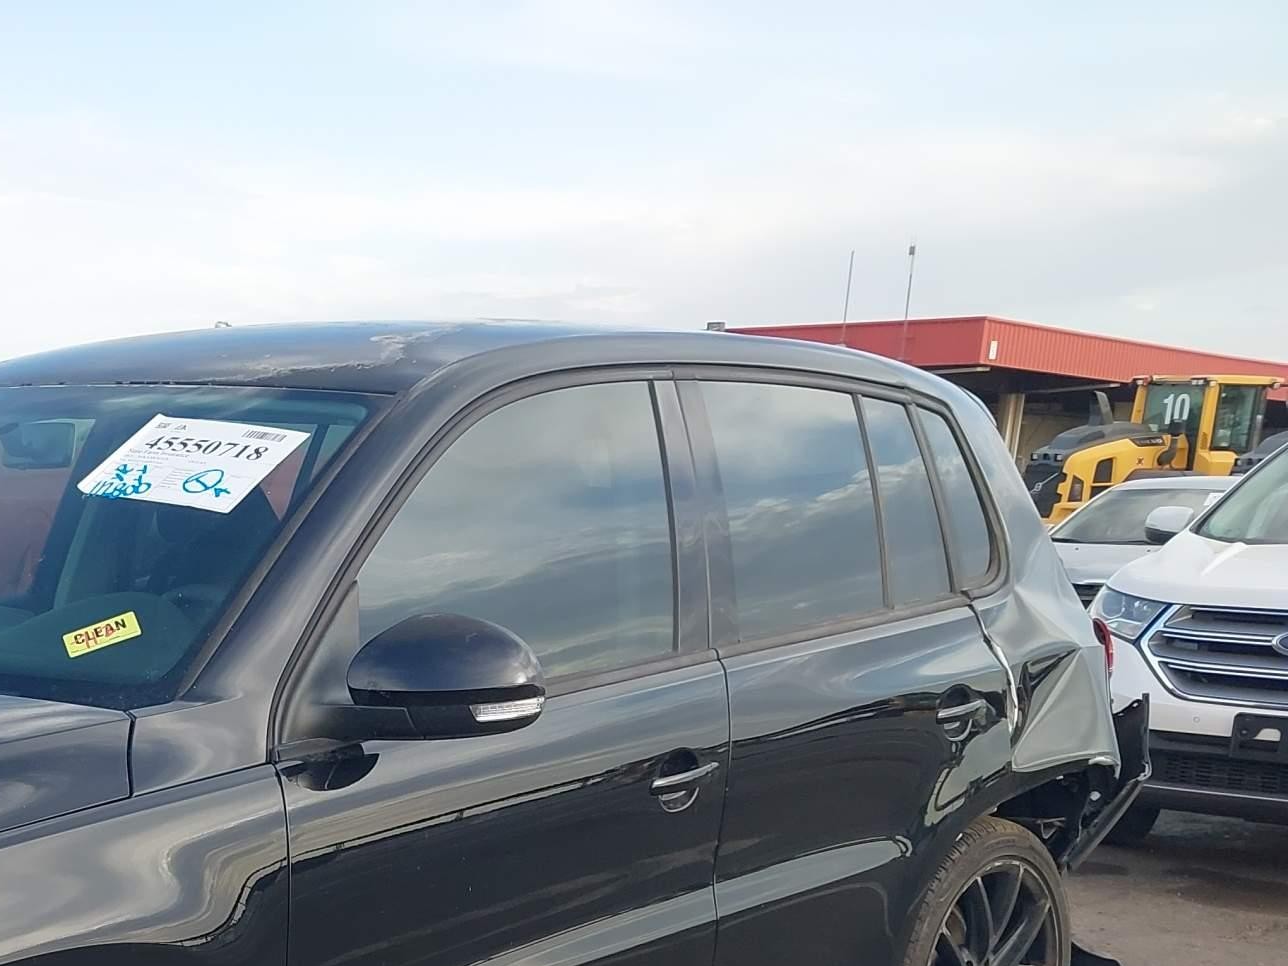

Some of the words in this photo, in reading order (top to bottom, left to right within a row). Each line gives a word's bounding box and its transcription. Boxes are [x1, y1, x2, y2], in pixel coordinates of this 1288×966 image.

[1163, 393, 1190, 425] 10
[145, 435, 269, 462] 45550718
[74, 619, 127, 645] CLEAN
